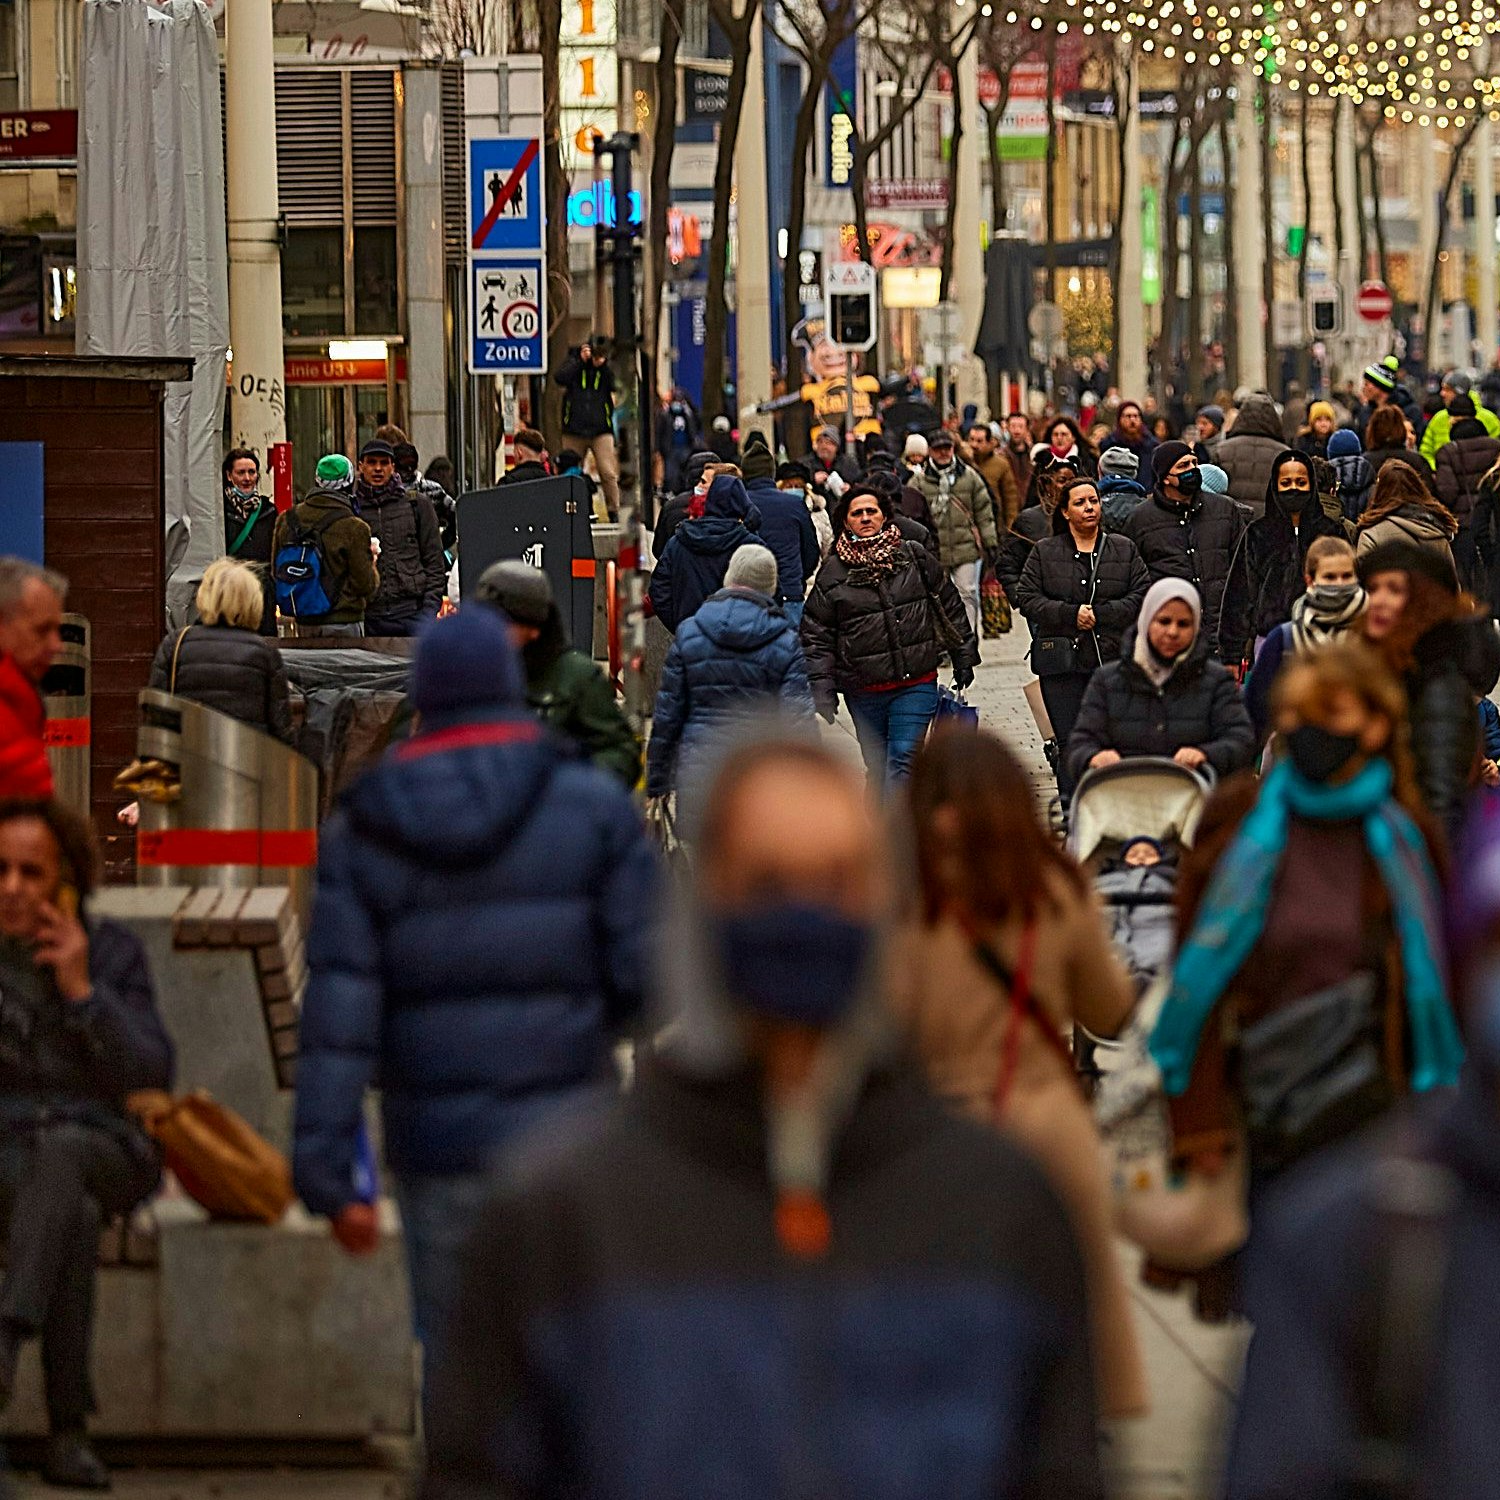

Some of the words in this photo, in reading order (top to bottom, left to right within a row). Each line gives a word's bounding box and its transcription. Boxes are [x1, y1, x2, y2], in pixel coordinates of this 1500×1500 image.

[1, 117, 29, 138] ER
[513, 312, 534, 333] 20
[484, 342, 531, 361] Zone
[322, 362, 345, 376] U3
[279, 446, 287, 475] STOP
